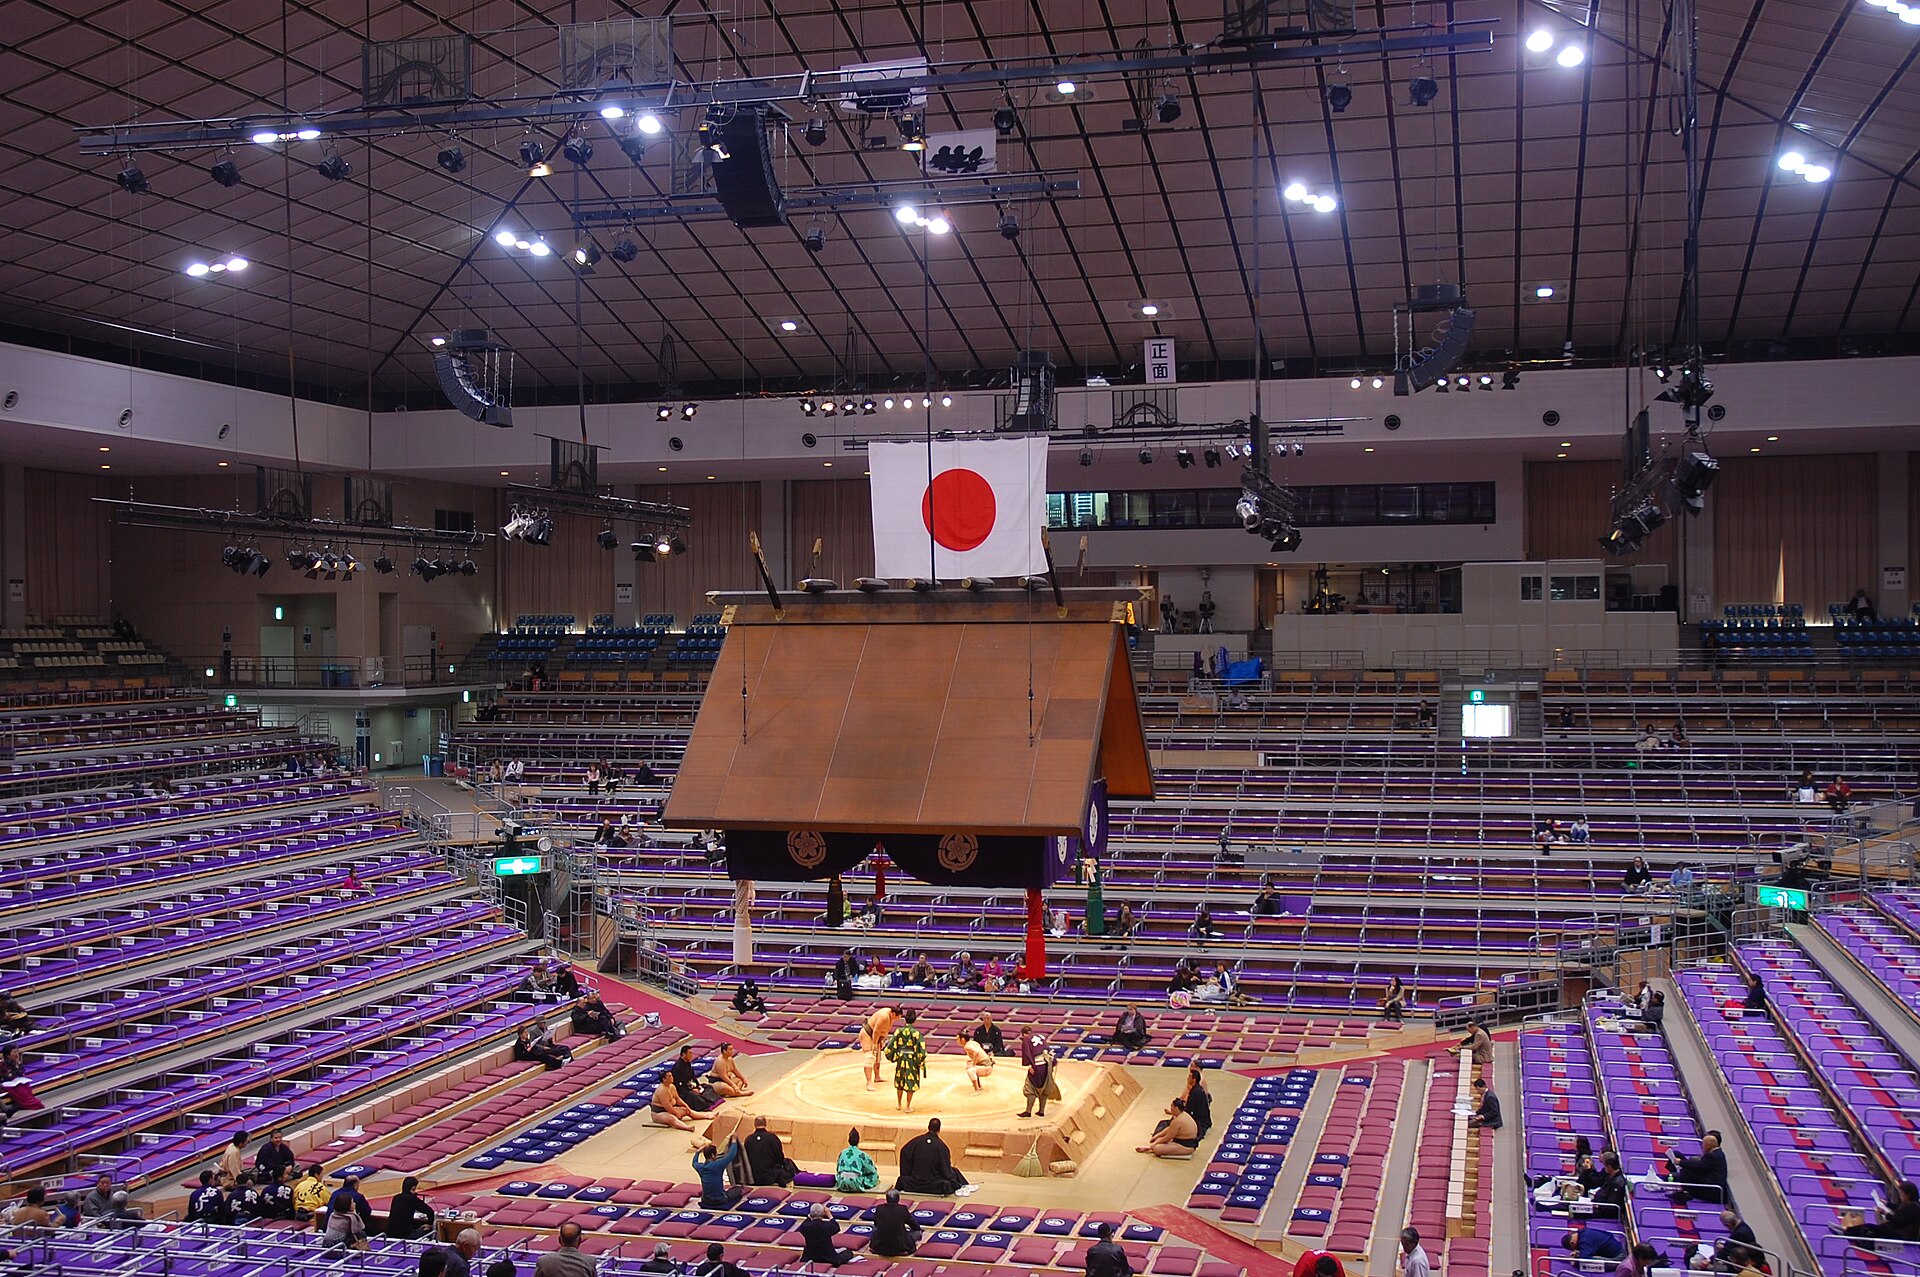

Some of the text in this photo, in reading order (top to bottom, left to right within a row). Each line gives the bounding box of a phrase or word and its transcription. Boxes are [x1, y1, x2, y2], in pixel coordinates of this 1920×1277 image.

[1151, 343, 1169, 379] 正面
[194, 1186, 218, 1212] なとり
[230, 1189, 258, 1212] 紀文
